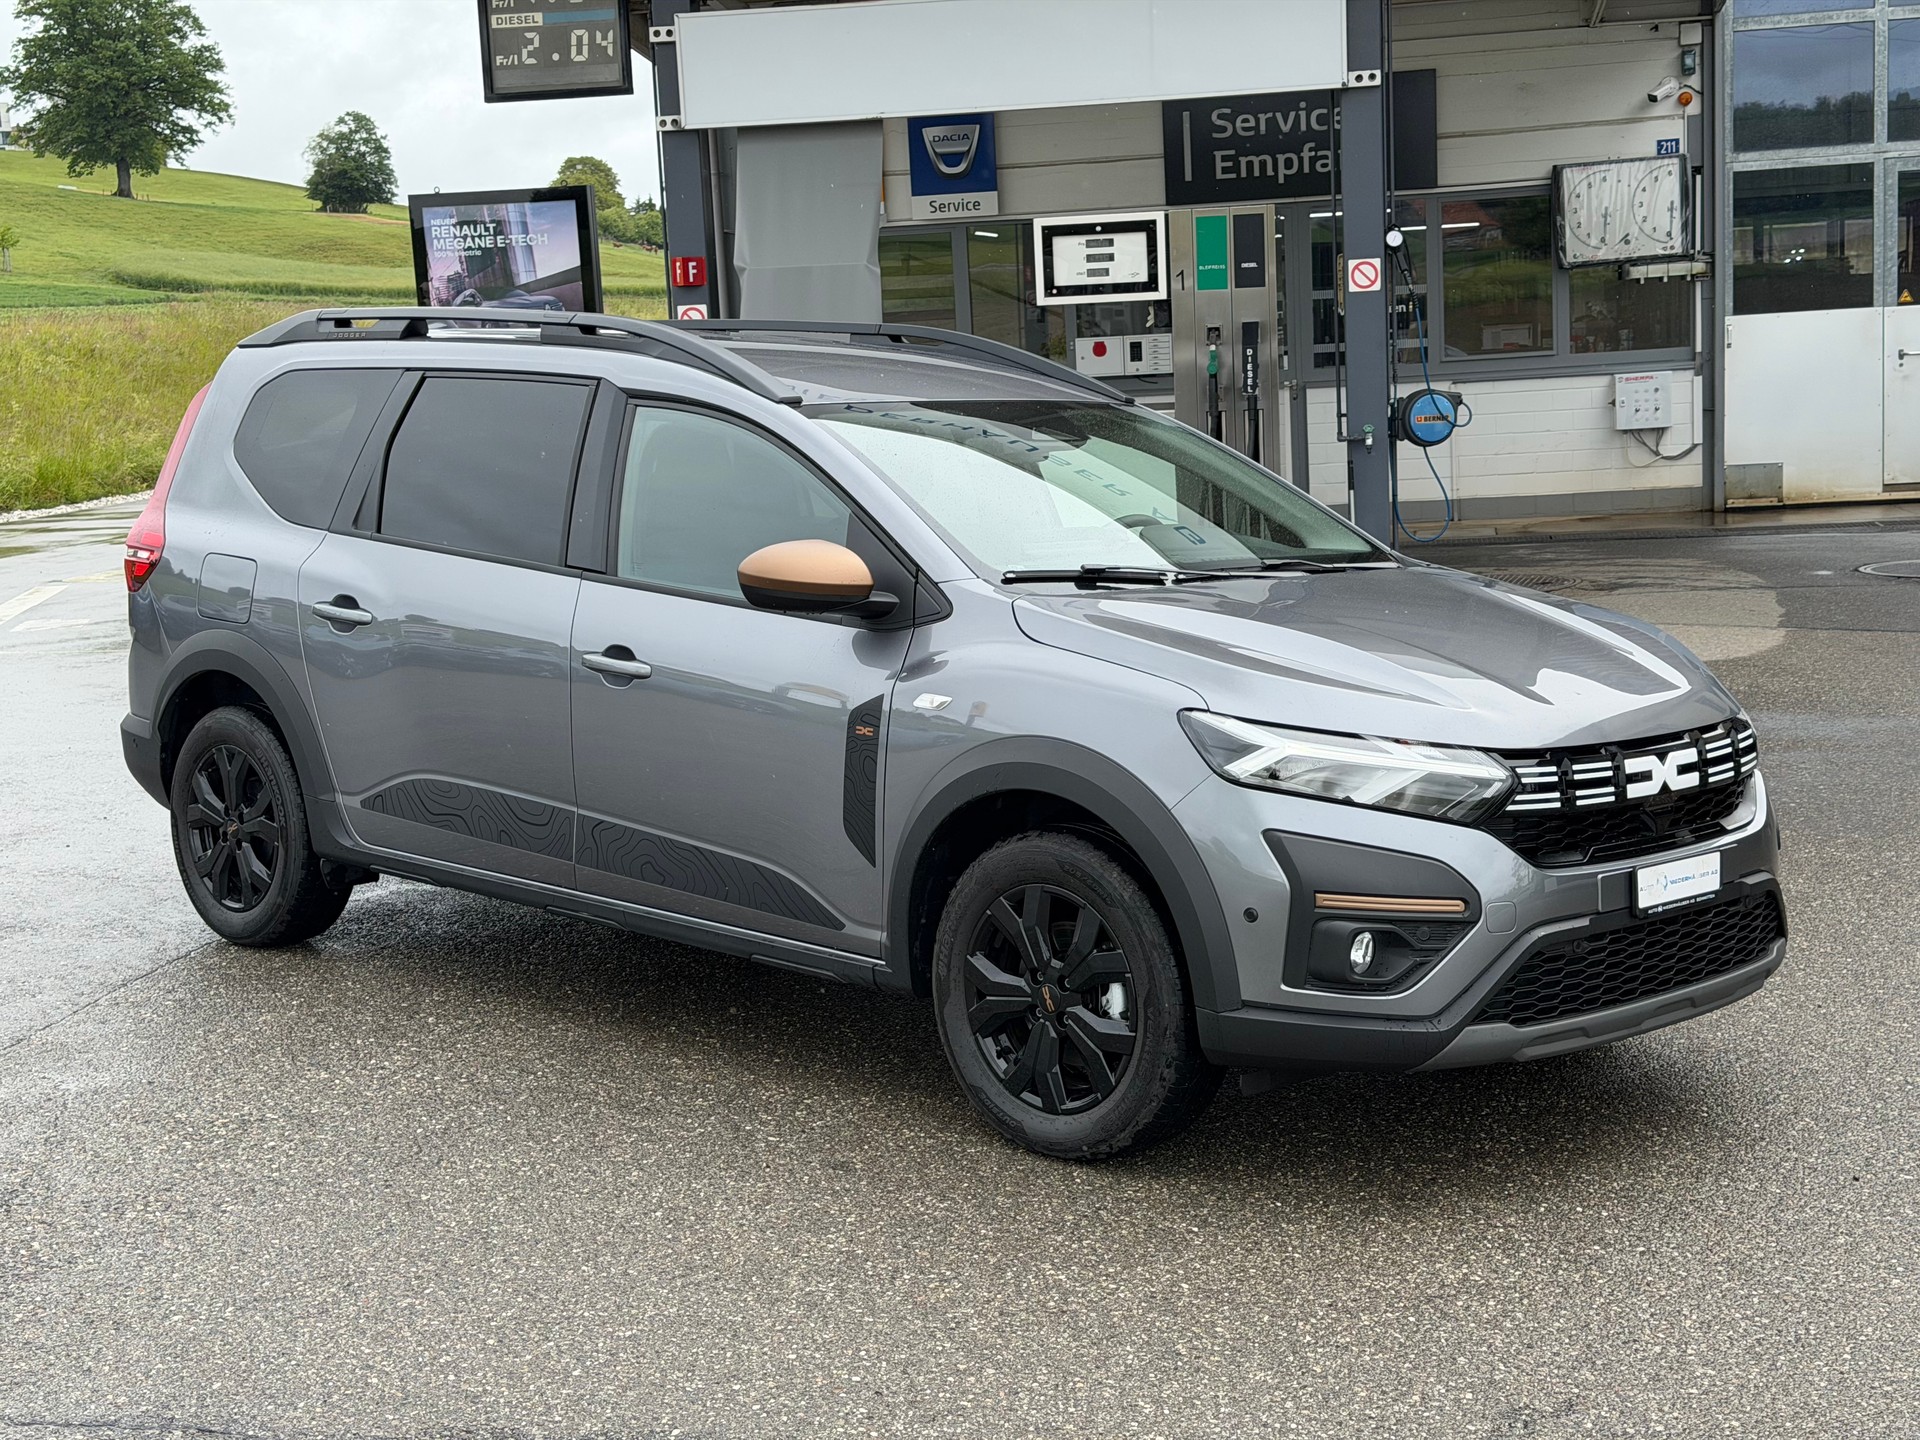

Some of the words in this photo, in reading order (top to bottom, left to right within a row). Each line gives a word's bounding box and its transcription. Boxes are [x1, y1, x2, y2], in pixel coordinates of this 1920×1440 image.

[495, 15, 539, 26] DIESEL
[522, 29, 613, 65] 2.04
[932, 133, 970, 142] DACIA
[1660, 140, 1676, 153] 211
[1213, 142, 1341, 183] Empfa
[929, 198, 981, 213] Service
[430, 218, 456, 226] NEUER
[431, 224, 496, 238] RENAULT
[433, 236, 495, 251] MEGANE
[497, 233, 548, 248] E-TECH
[688, 262, 697, 282] F
[1176, 269, 1185, 291] 1
